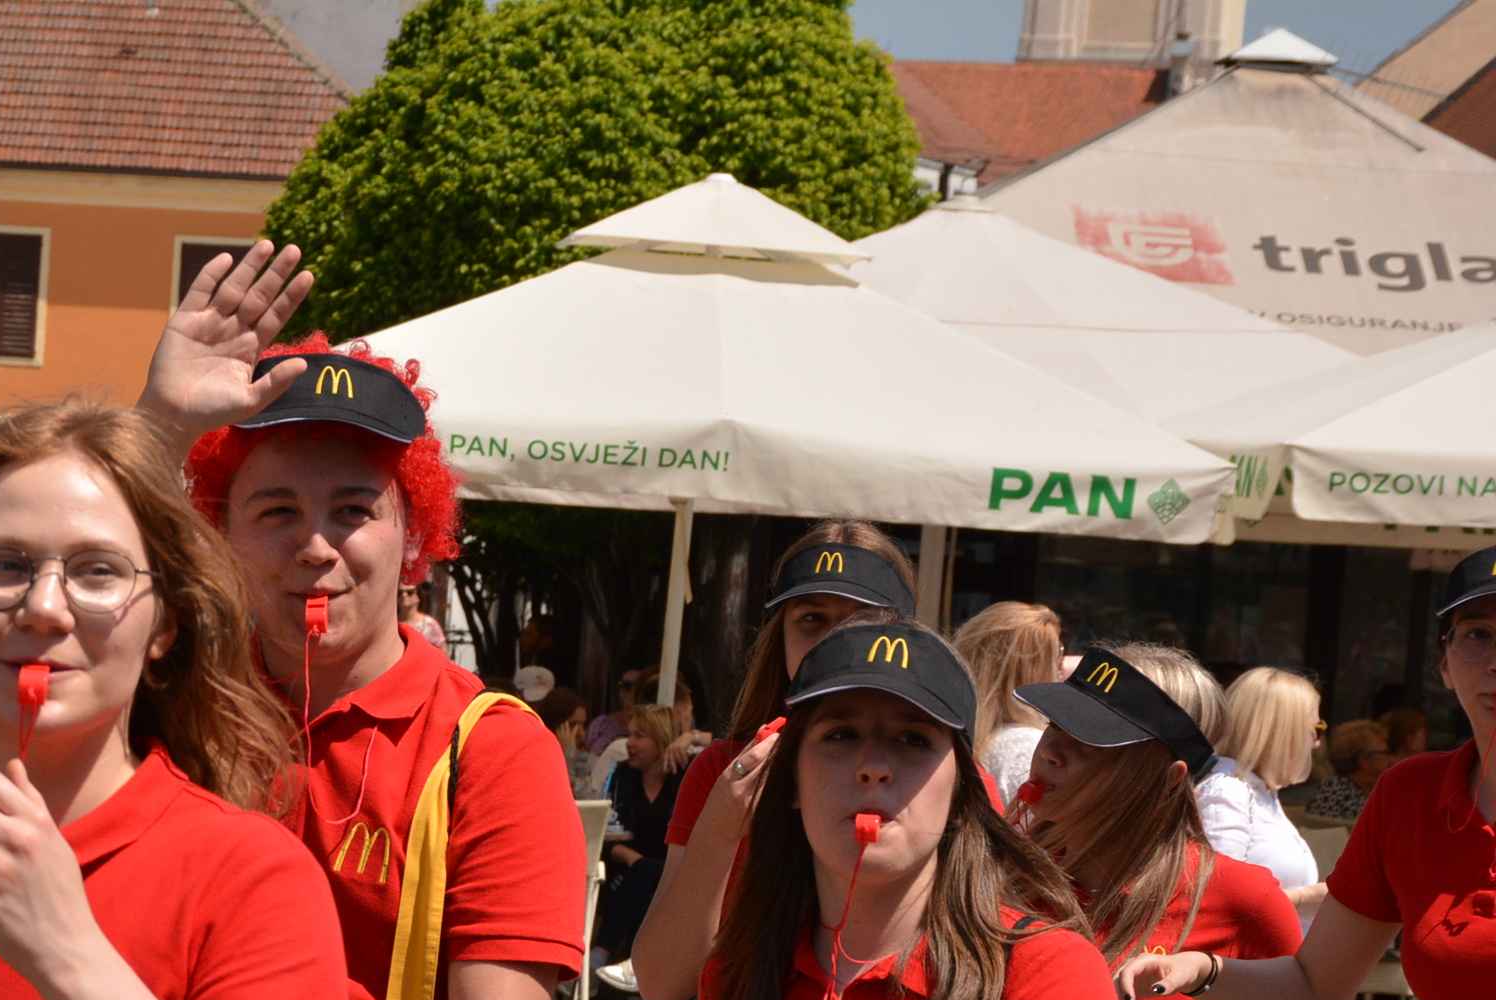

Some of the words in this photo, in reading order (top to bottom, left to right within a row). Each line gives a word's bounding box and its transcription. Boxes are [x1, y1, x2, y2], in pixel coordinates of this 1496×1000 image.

[450, 434, 515, 462] PAN,
[527, 439, 647, 466] OSVJEŽI
[658, 448, 730, 472] DAN!
[988, 467, 1137, 519] PAN
[1329, 471, 1448, 496] POZOVI
